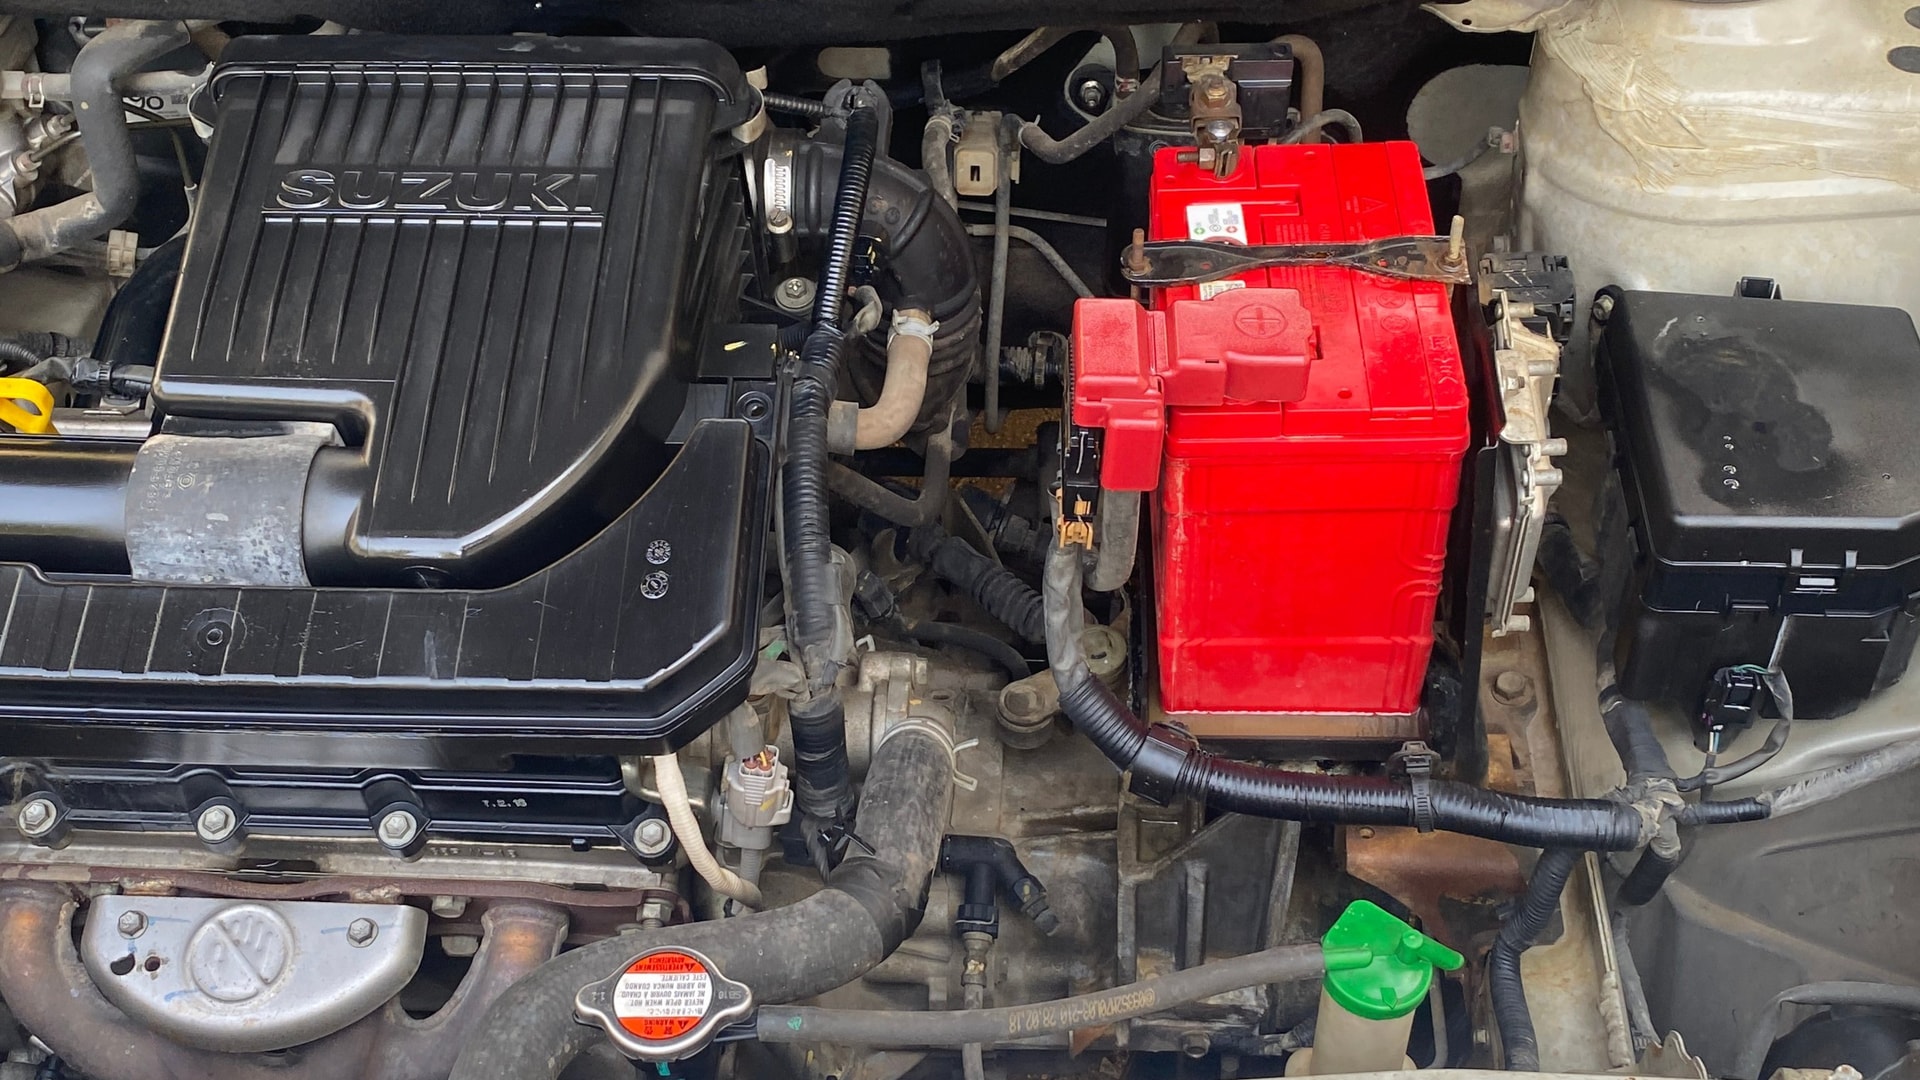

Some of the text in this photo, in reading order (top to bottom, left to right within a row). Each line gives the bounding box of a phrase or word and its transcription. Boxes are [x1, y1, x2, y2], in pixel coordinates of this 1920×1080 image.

[275, 168, 598, 212] SUZUKI
[635, 963, 684, 971] AVERTISSEMENT
[625, 982, 707, 990] NO ABRIR NUNCA CUANDO
[697, 990, 706, 998] NE
